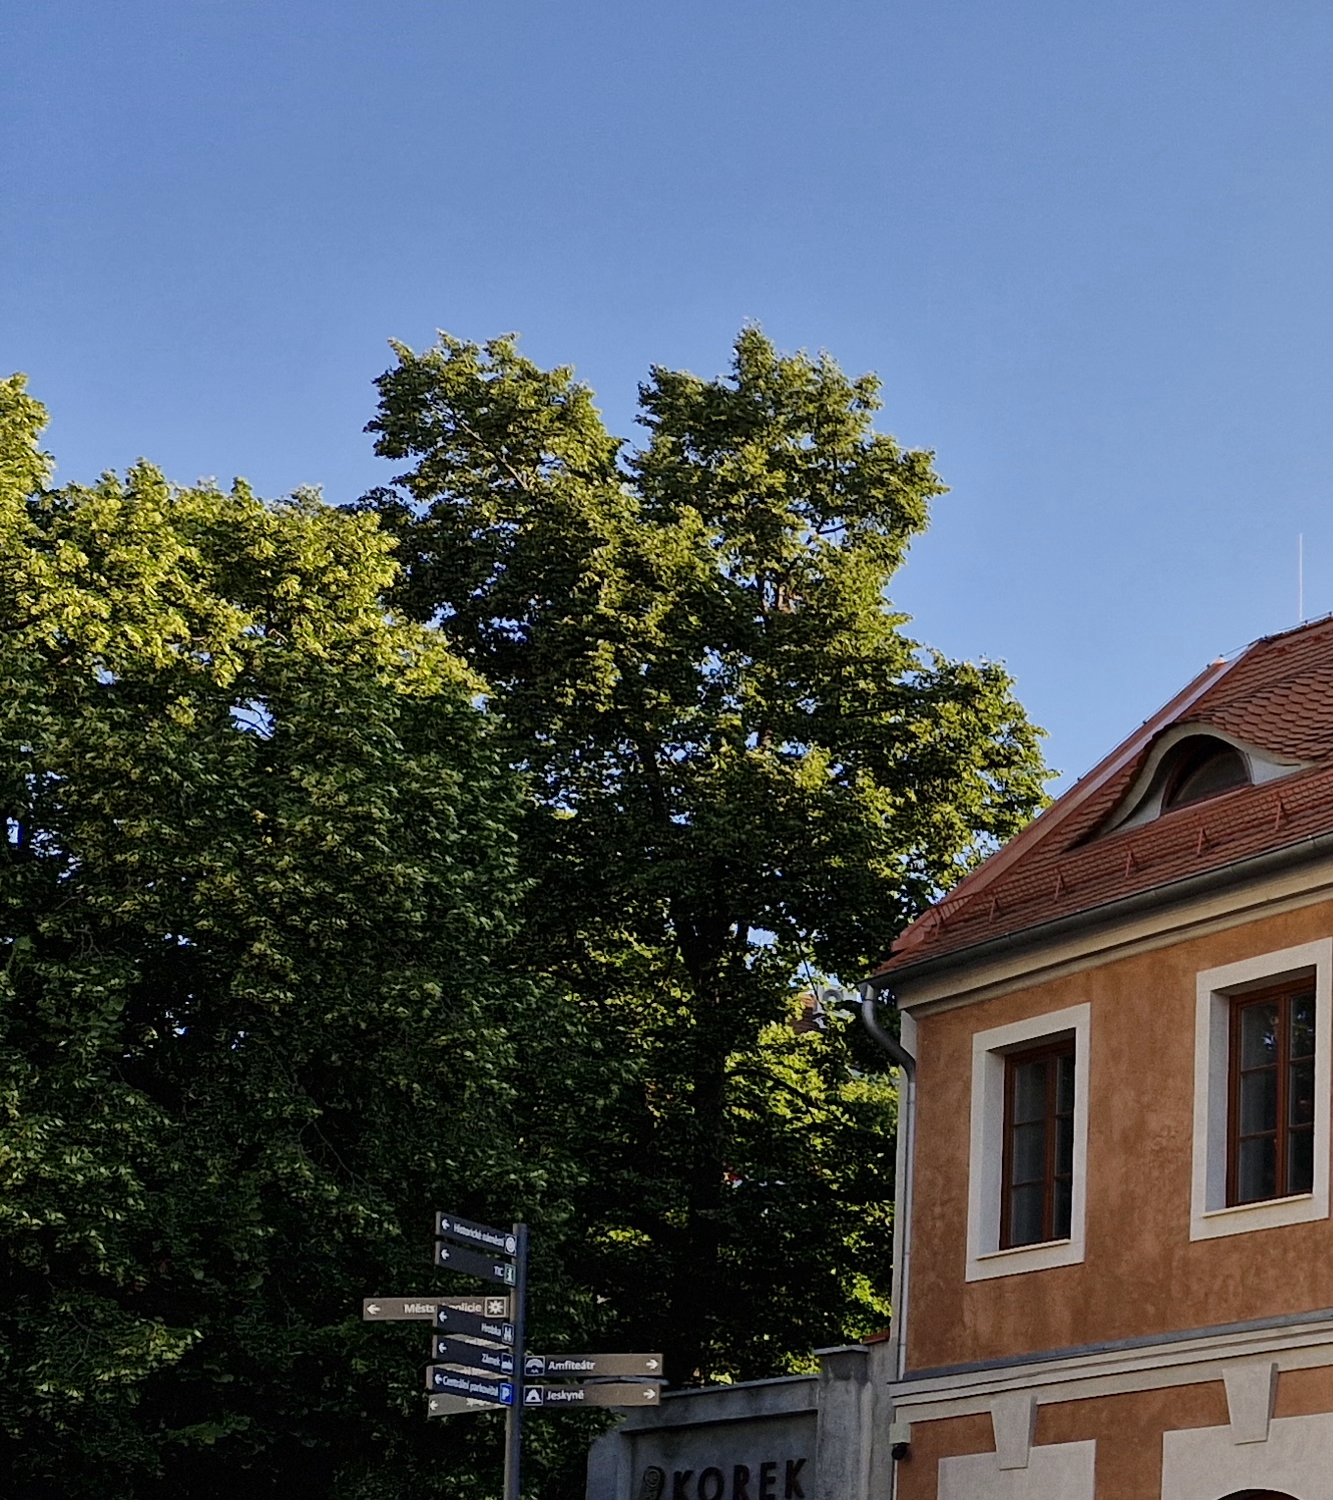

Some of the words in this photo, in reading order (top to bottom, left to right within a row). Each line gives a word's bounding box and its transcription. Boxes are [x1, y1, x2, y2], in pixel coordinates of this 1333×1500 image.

[404, 1303, 447, 1314] Městs
[548, 1359, 595, 1371] Amfiteátr
[547, 1388, 584, 1401] Jeskyně
